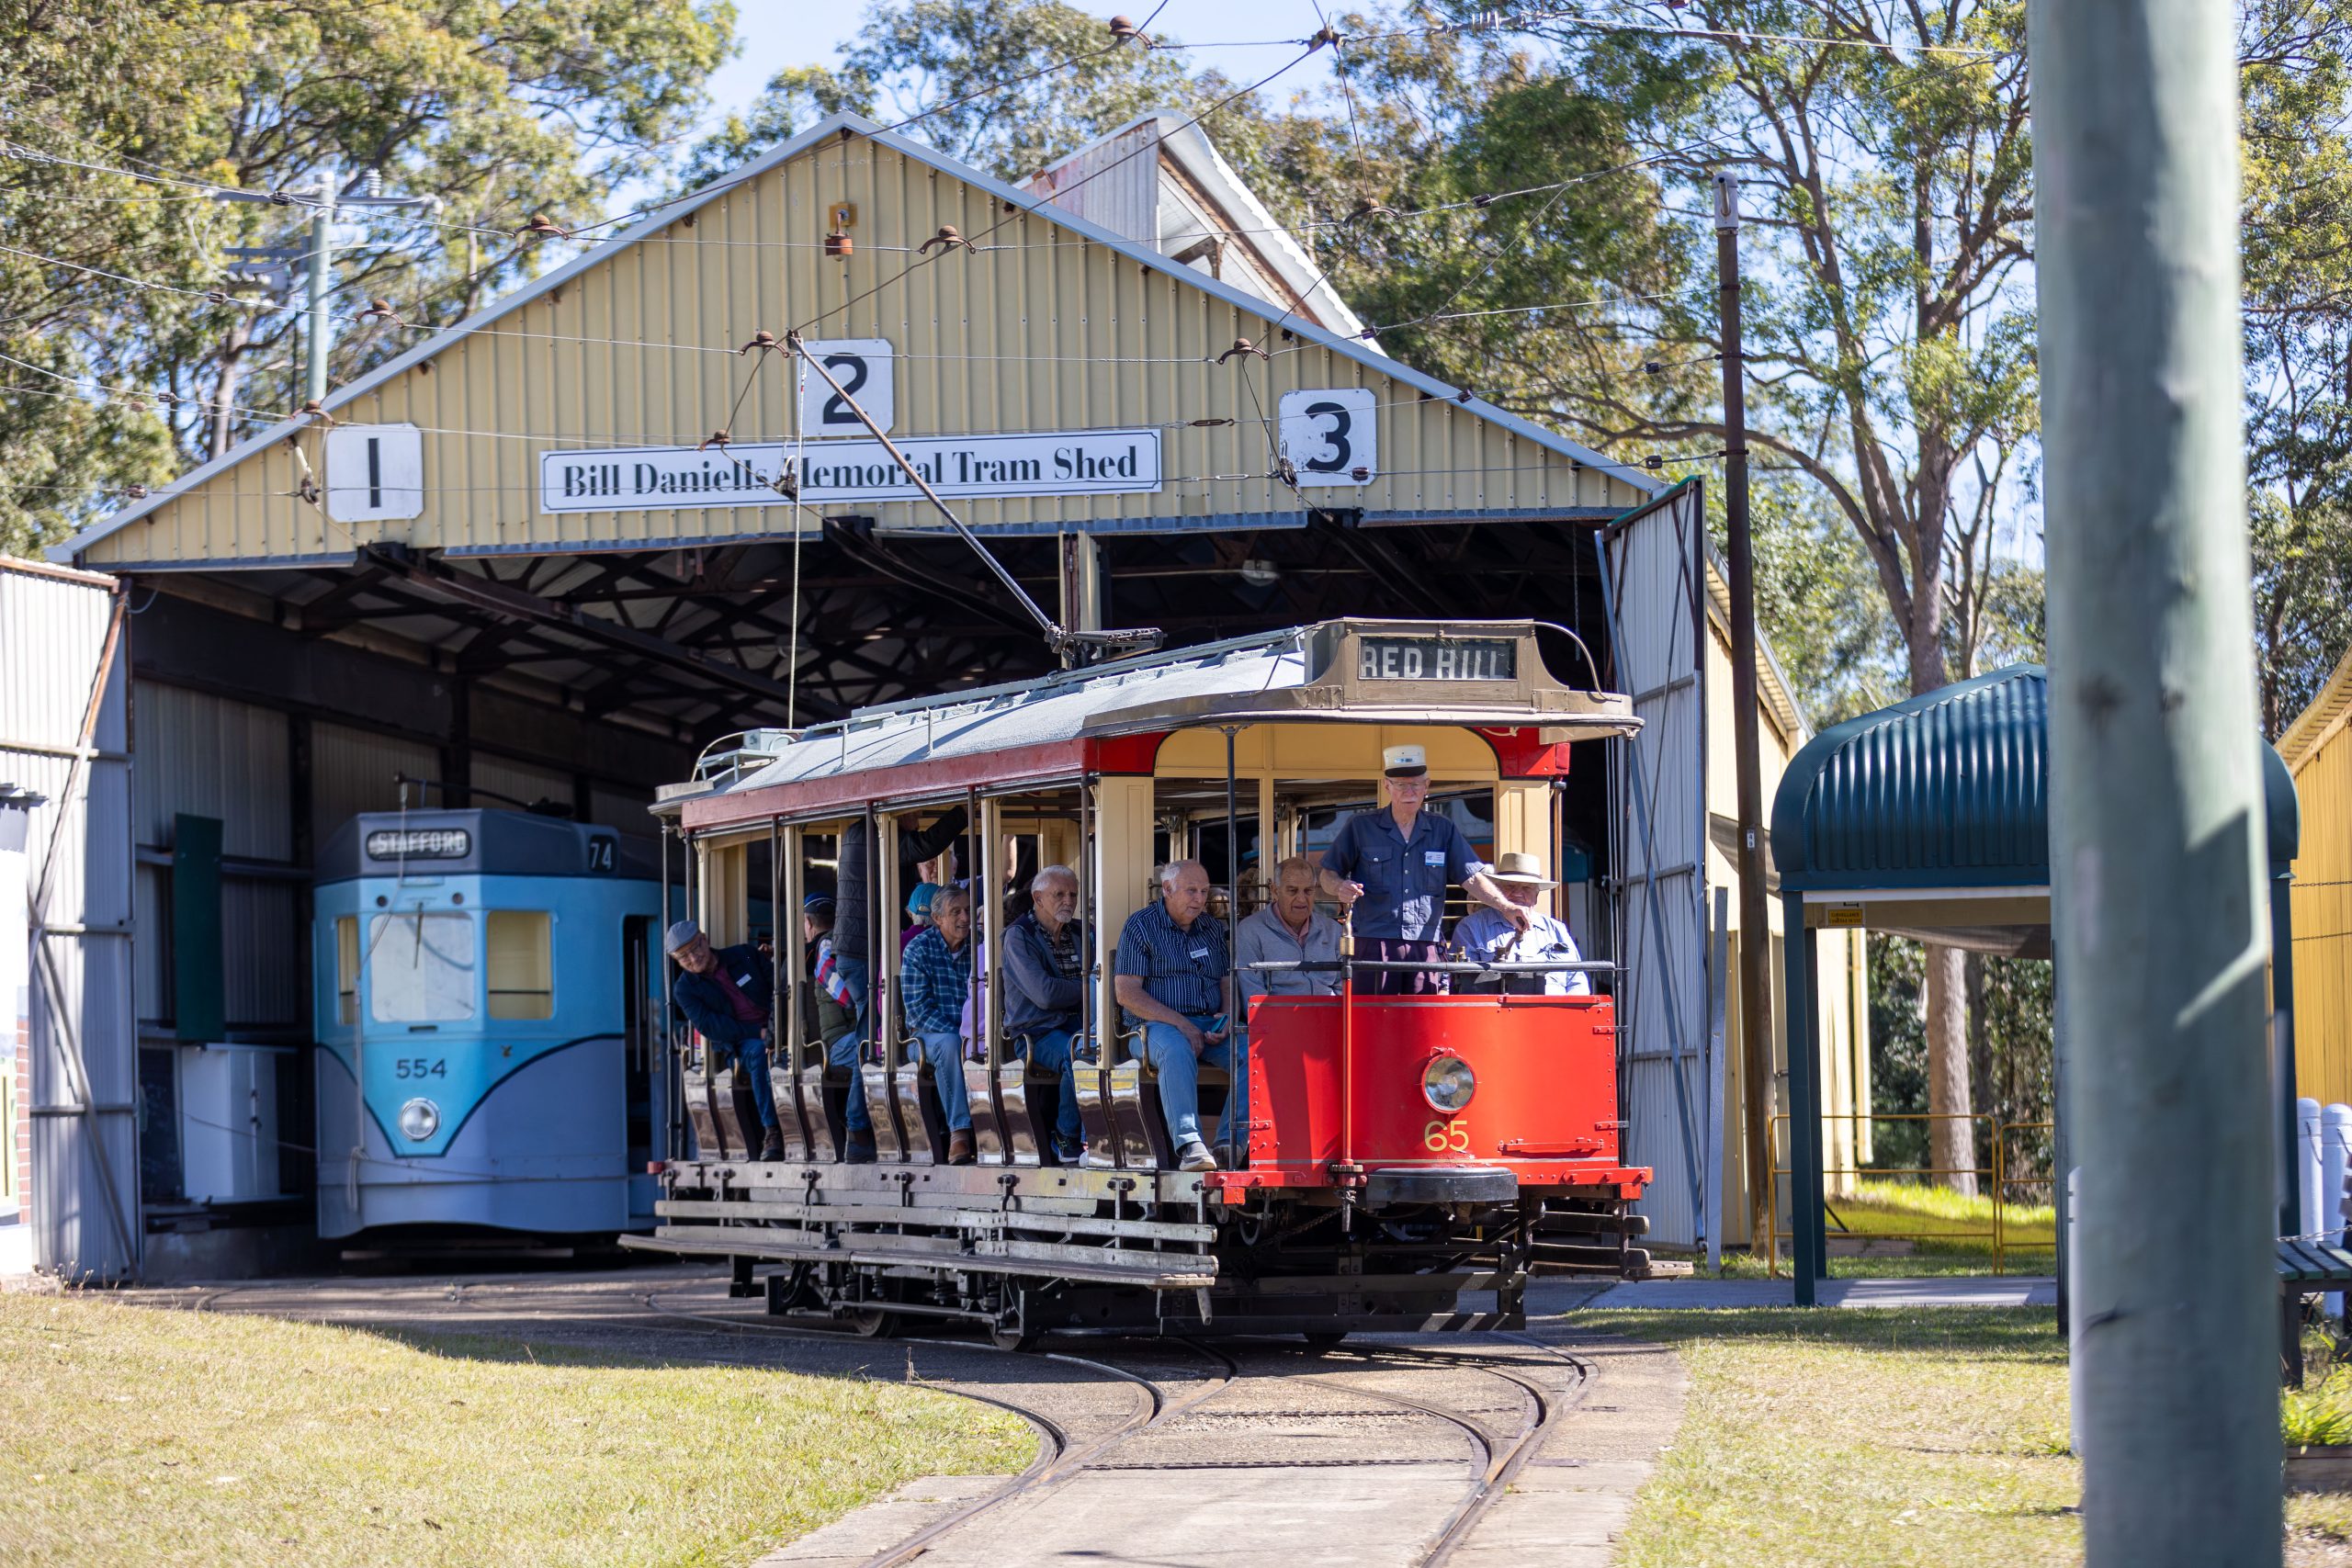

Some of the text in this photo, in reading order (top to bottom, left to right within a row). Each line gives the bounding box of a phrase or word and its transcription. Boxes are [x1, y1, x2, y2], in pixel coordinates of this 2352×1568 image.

[822, 352, 867, 424] 2
[1305, 401, 1351, 473] 3
[563, 464, 620, 497] Bill
[634, 459, 768, 494] Daniells
[952, 451, 1041, 482] Tram
[1055, 446, 1138, 479] Shed
[1361, 646, 1506, 679] RED HILL
[377, 830, 467, 854] STAFFORD
[591, 842, 612, 870] 74
[396, 1058, 447, 1079] 554
[1424, 1120, 1469, 1152] 65
